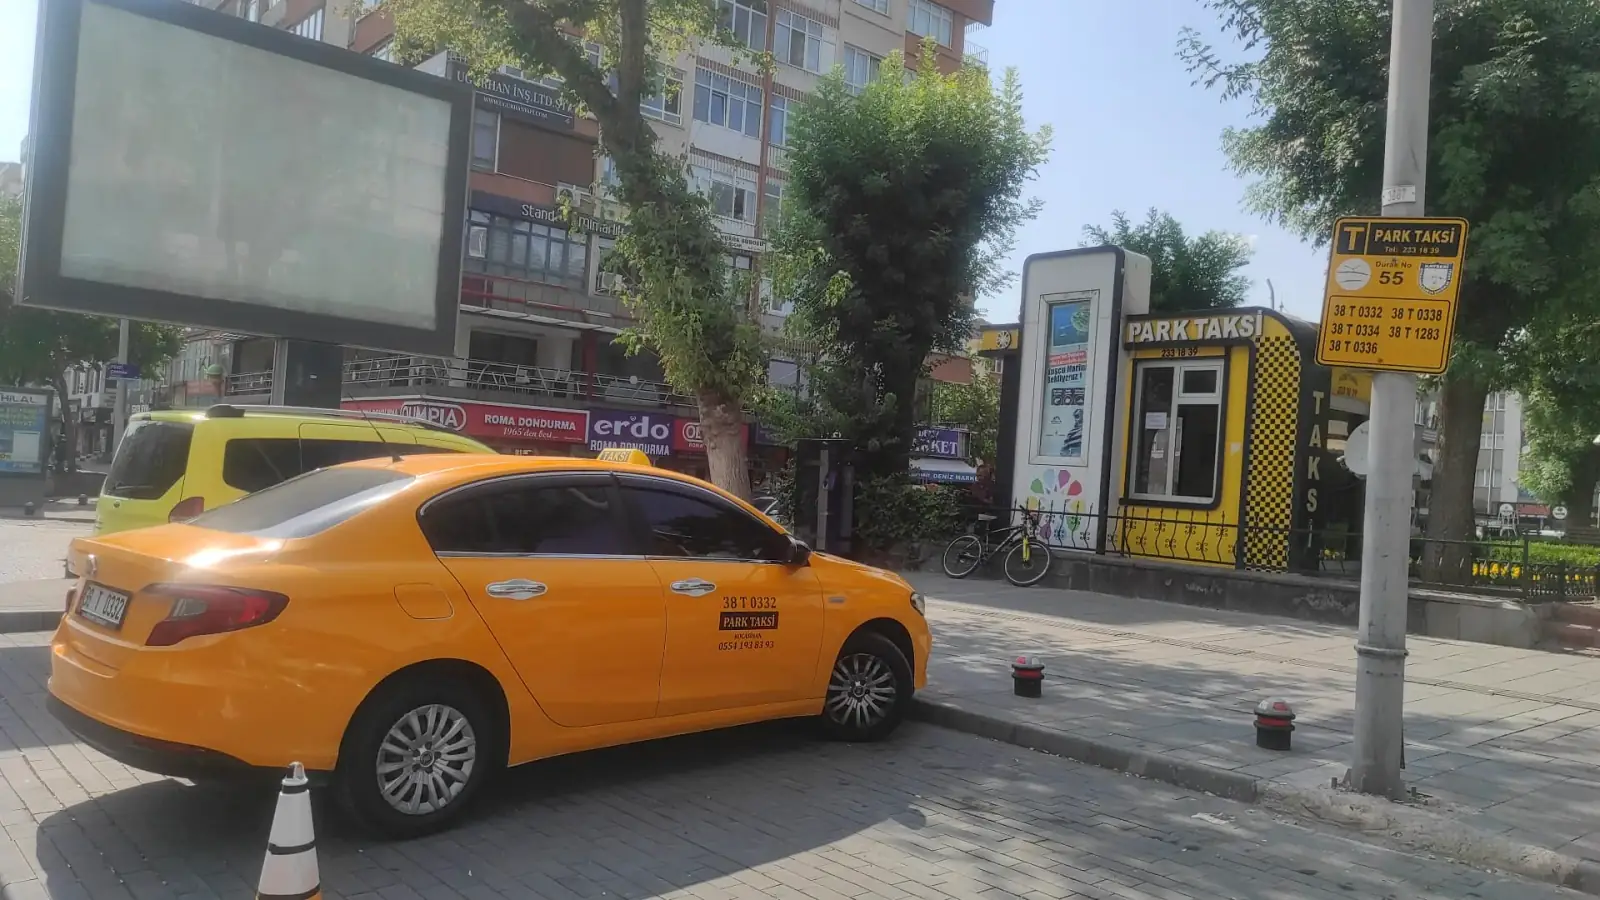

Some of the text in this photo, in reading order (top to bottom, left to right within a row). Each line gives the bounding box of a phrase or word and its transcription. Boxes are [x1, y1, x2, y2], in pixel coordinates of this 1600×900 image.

[1343, 226, 1365, 251] T
[1374, 227, 1455, 243] PARK TAKSİ
[1402, 246, 1417, 254] 233
[1419, 246, 1428, 254] 18
[1401, 261, 1412, 269] No
[1379, 271, 1404, 285] 55
[1334, 304, 1383, 319] 38 T 0332
[1391, 307, 1443, 321] 38 T 0338
[1127, 310, 1263, 343] PARK TAKSİ
[1331, 323, 1380, 337] 38 T 0334
[1388, 326, 1440, 341] 38 T 1283
[1161, 347, 1199, 358] 233 18 39
[1329, 340, 1378, 354] 38 T 0336
[484, 413, 576, 431] ROMA DONDURMA
[594, 416, 669, 440] erdo
[590, 439, 670, 456] ROMA DONDURMA
[602, 451, 628, 462] TAKSİ
[102, 594, 125, 620] 0332
[723, 596, 777, 609] 38 T 0332
[723, 614, 776, 628] PARK TAKSİ
[740, 641, 753, 650] 193
[765, 640, 775, 649] 93
